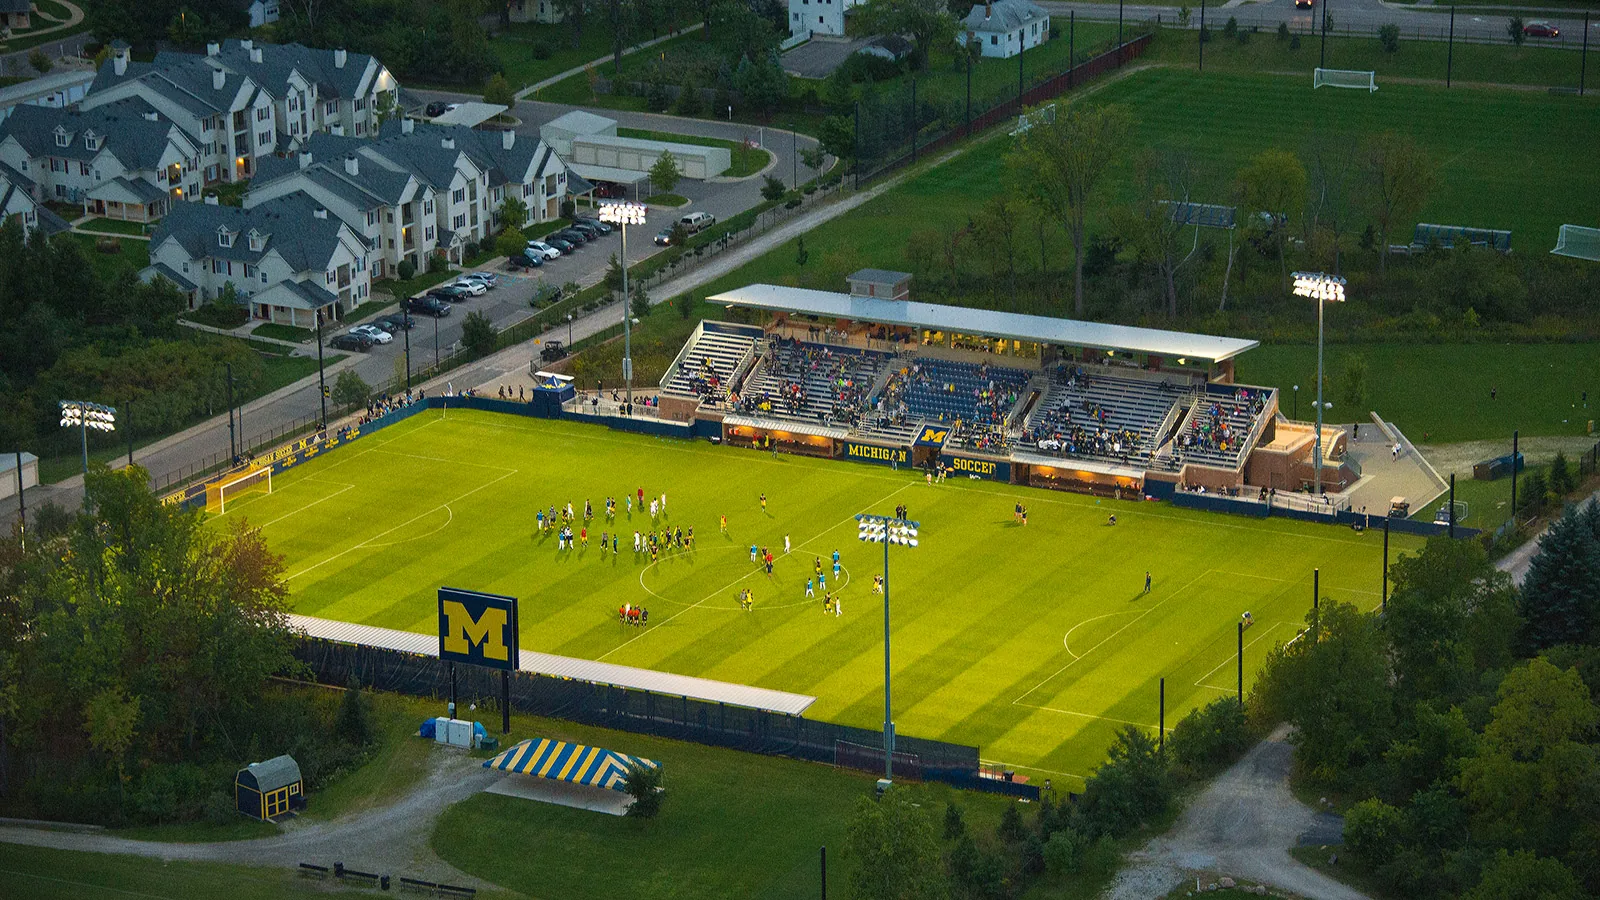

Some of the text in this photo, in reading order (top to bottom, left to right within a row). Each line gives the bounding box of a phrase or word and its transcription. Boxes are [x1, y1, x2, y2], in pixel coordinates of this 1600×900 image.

[921, 429, 946, 443] M
[848, 444, 907, 462] MICHIGAN
[443, 600, 508, 661] M
